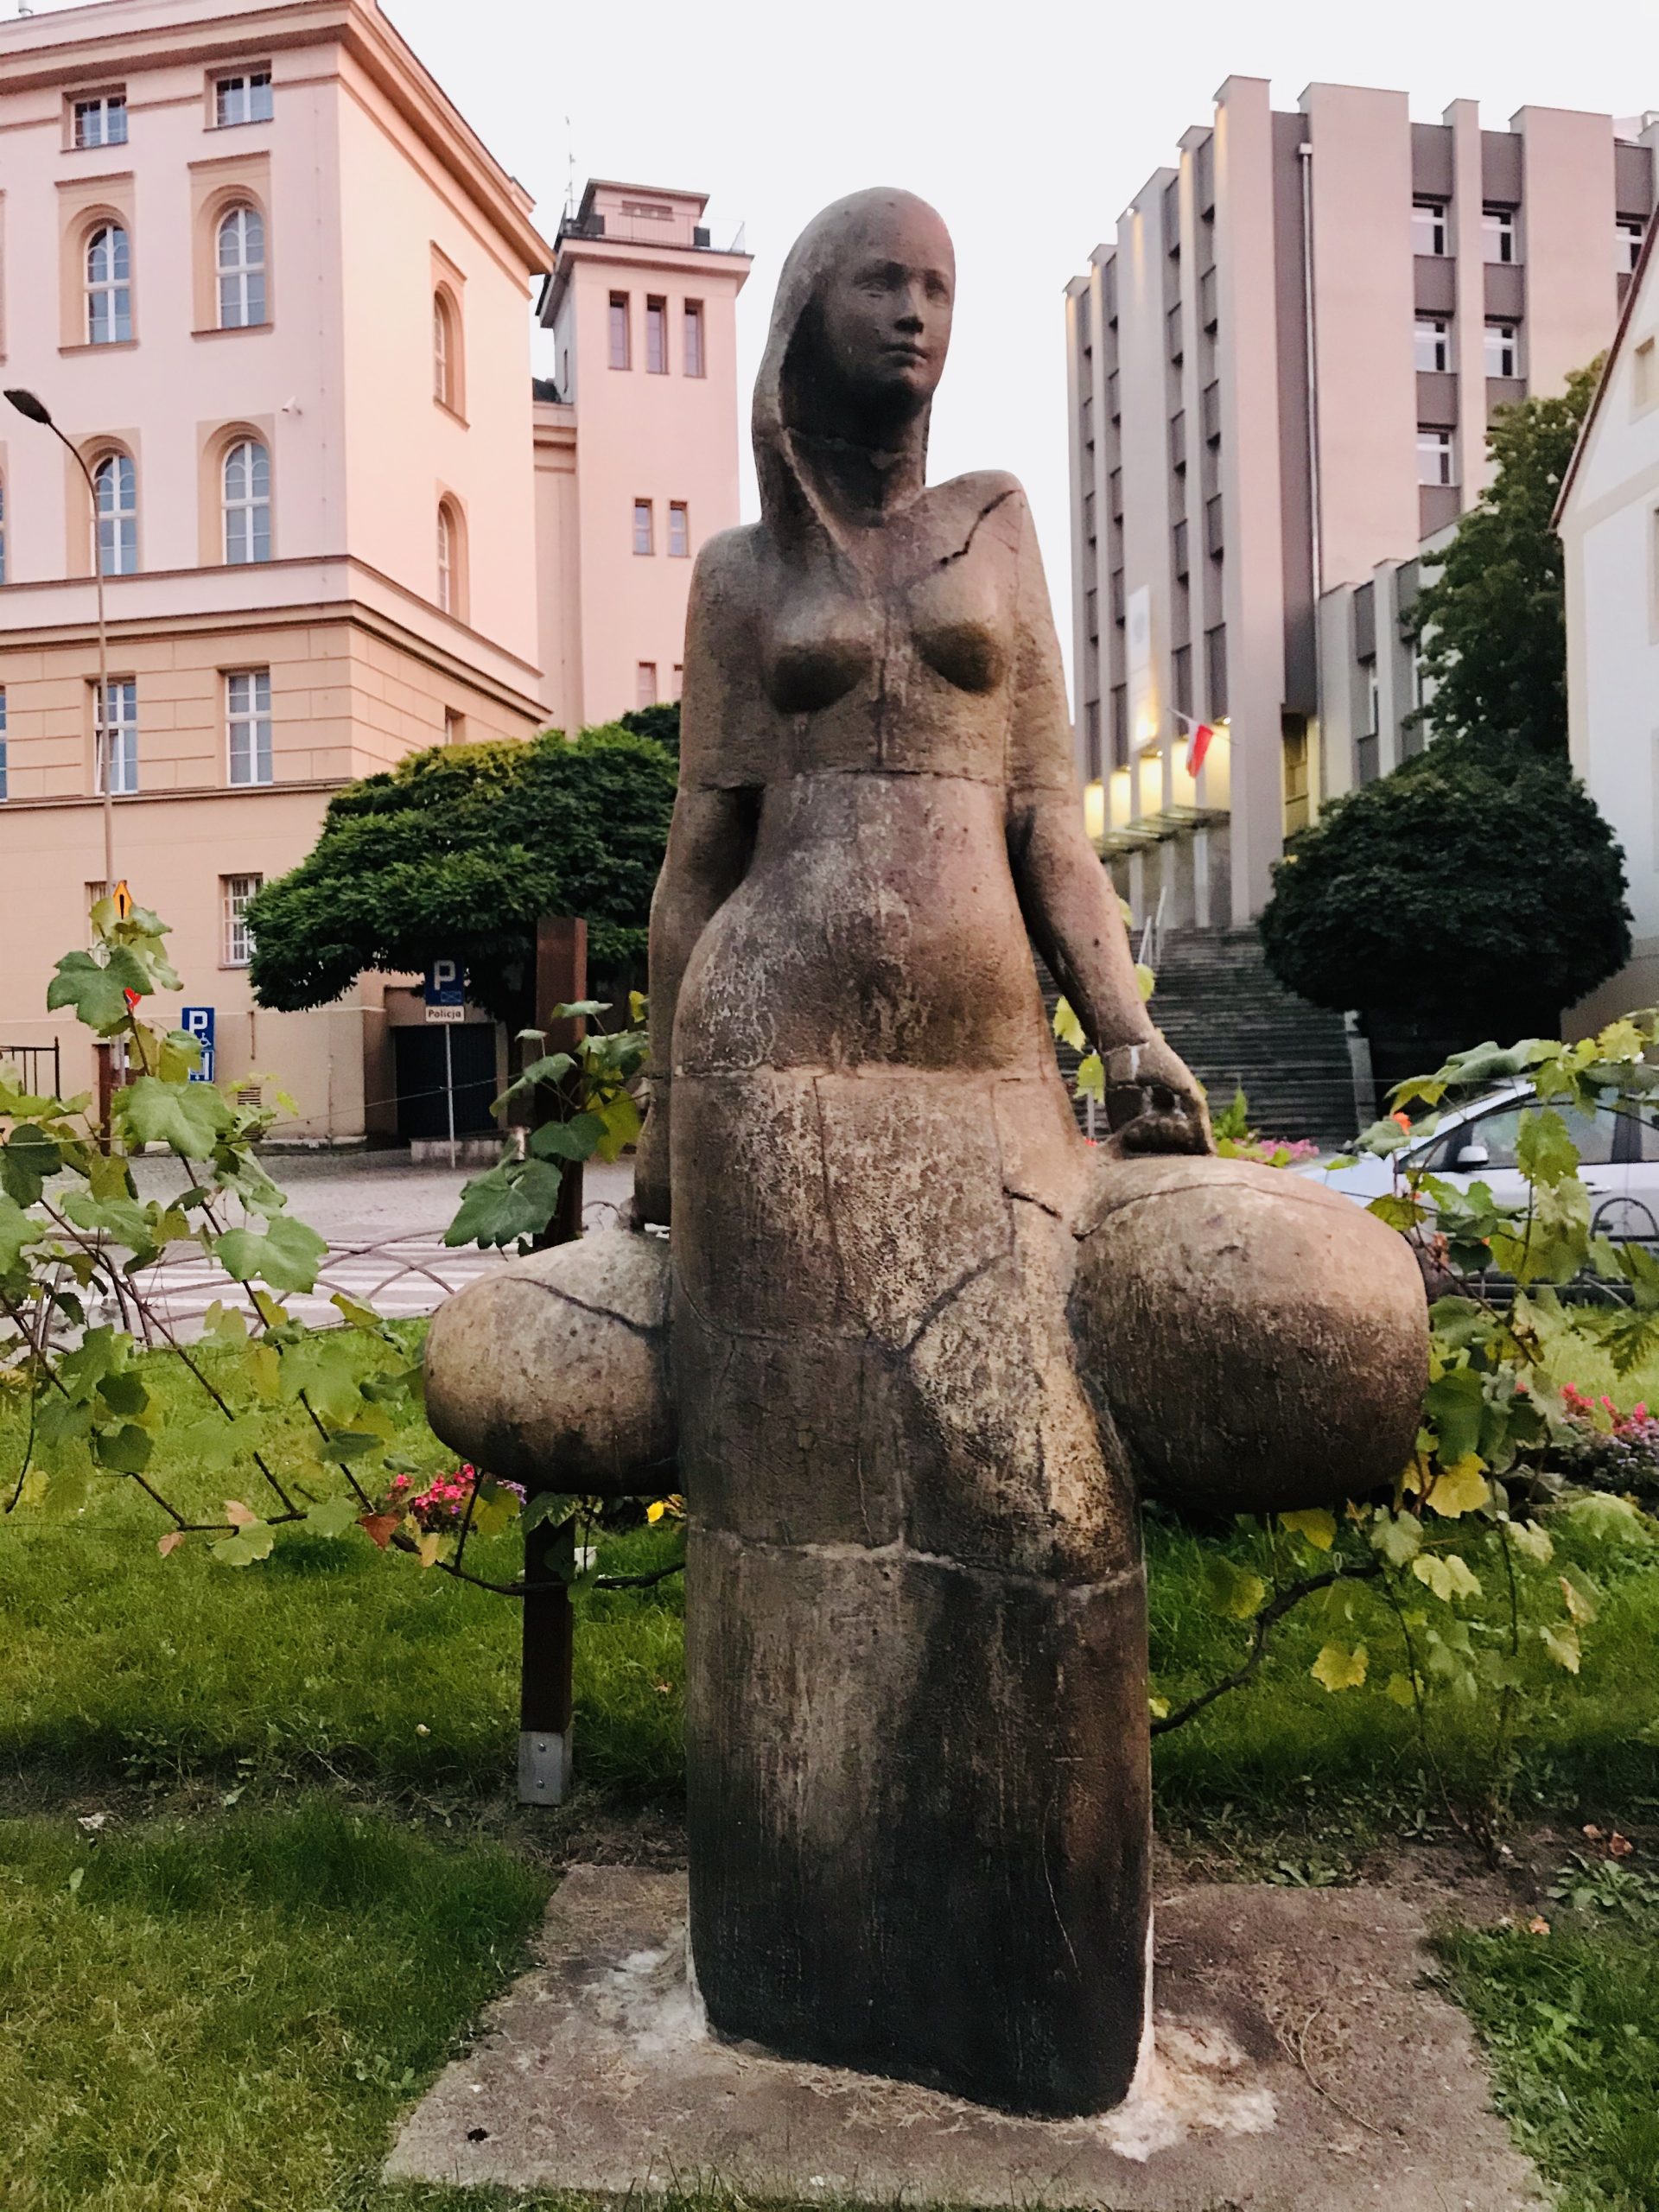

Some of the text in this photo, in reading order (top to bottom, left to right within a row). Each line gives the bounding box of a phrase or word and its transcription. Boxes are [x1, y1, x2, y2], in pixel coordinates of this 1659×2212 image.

[434, 959, 455, 990] P
[189, 1011, 208, 1034] P
[429, 1009, 461, 1020] Policja
